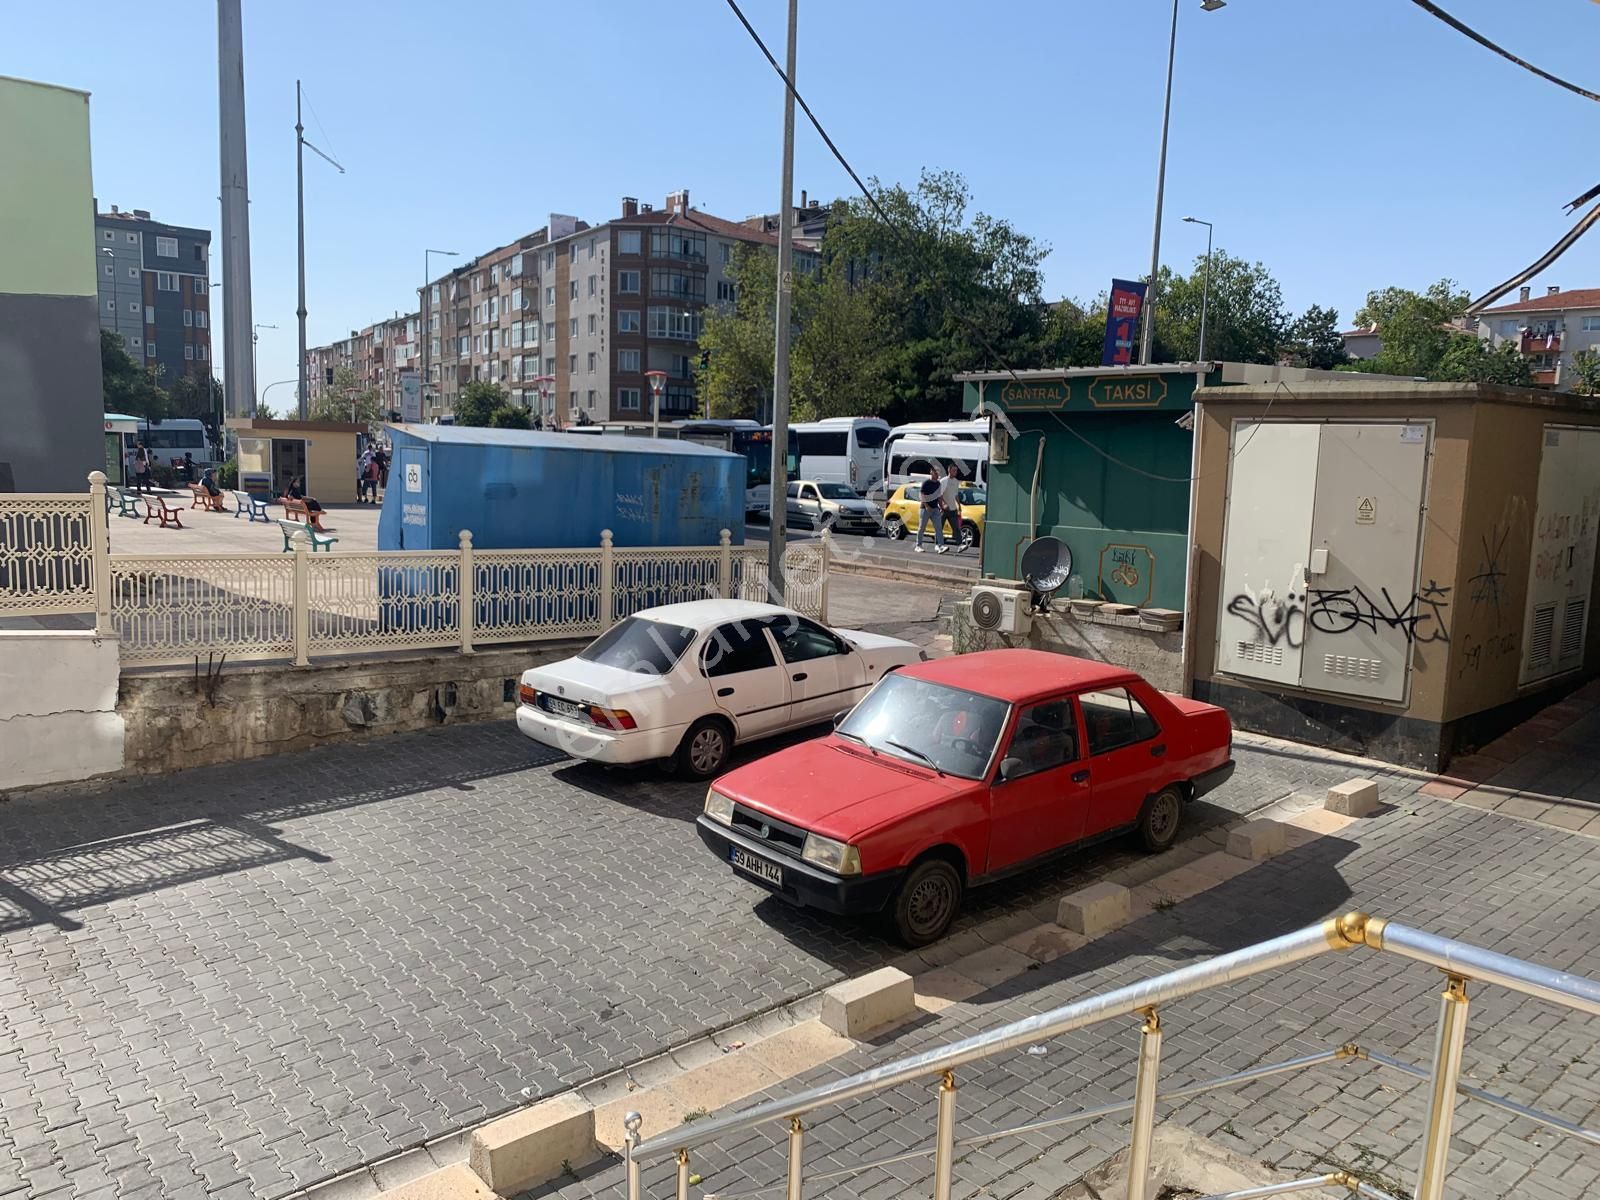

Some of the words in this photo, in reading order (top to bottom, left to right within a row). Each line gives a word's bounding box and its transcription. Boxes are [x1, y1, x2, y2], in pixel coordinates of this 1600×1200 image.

[1008, 388, 1062, 401] SANTRAL
[735, 850, 745, 866] 59
[746, 856, 763, 874] AHH
[765, 863, 780, 882] 144
